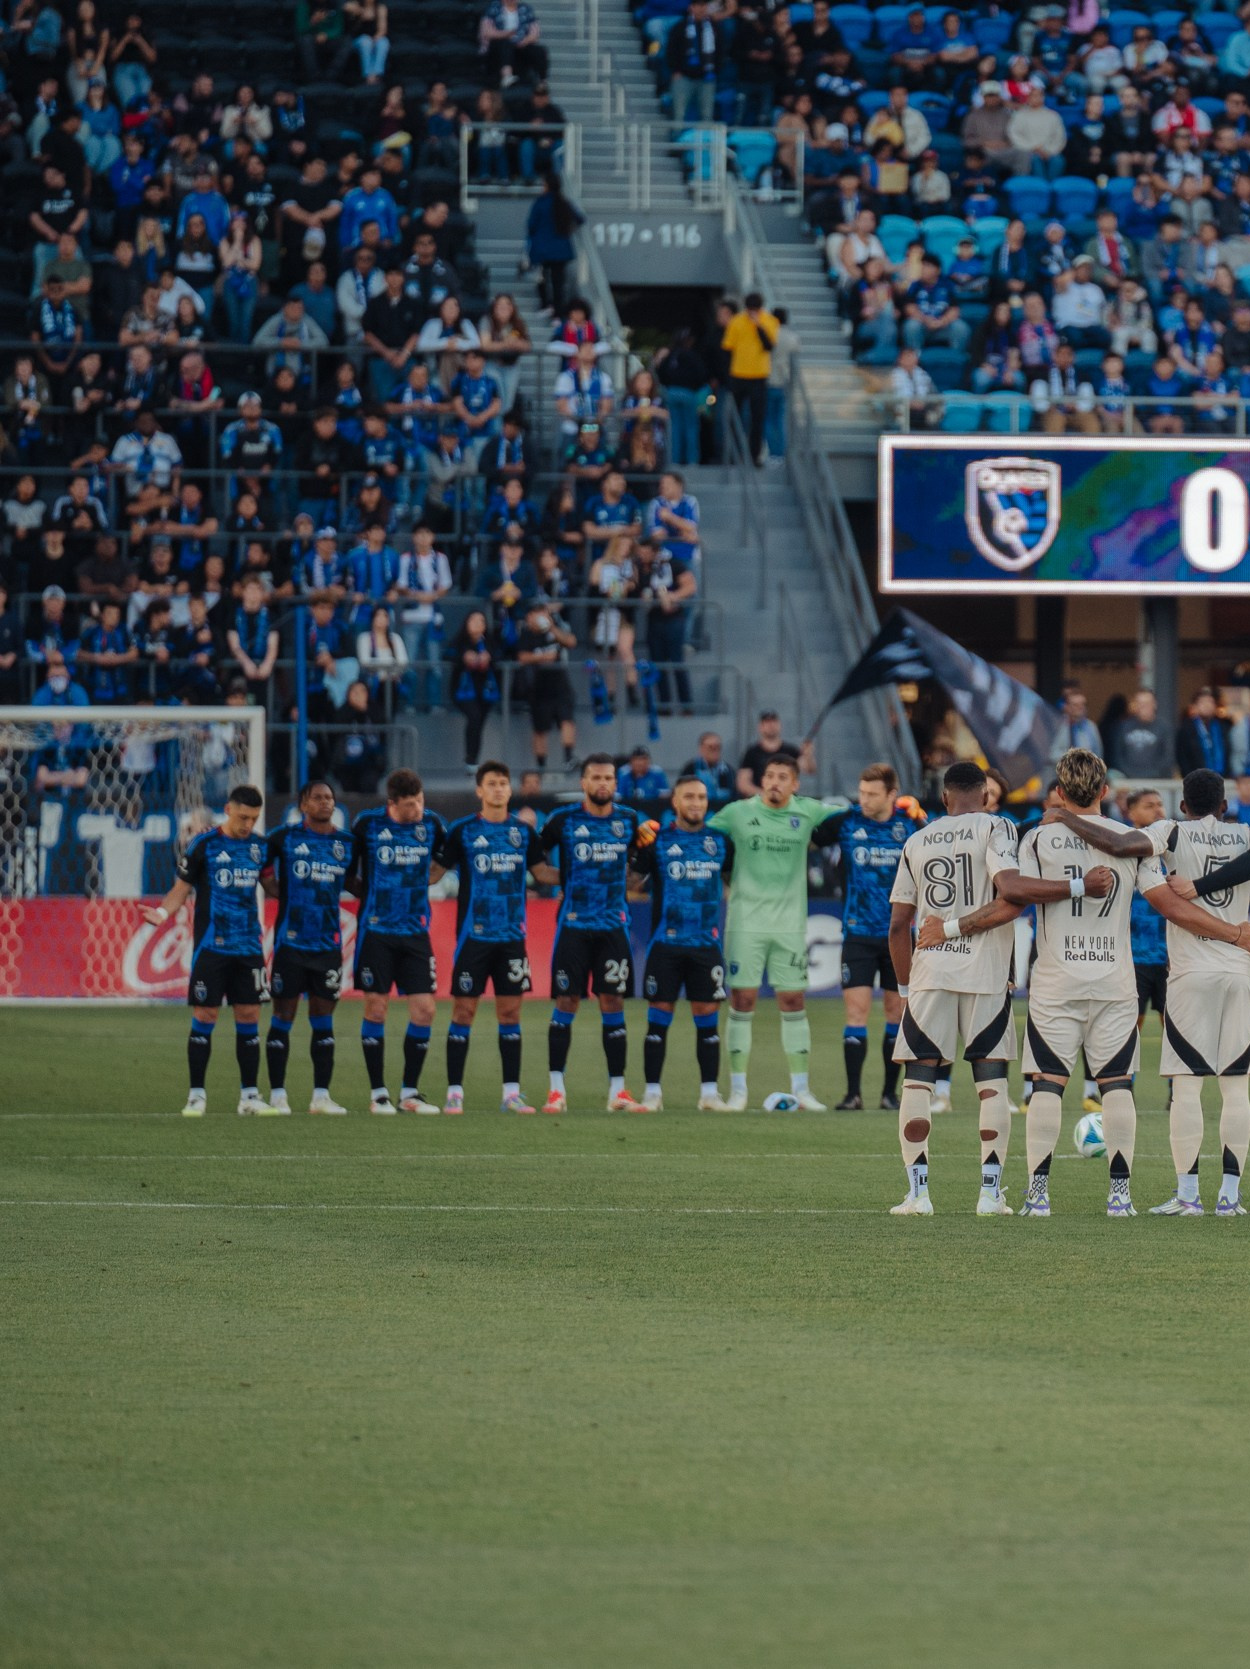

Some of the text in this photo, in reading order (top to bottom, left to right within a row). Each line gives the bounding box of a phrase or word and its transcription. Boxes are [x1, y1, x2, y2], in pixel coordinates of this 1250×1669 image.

[593, 222, 701, 248] 117 116
[1181, 467, 1248, 573] 0
[923, 828, 974, 847] NGOMA
[924, 852, 975, 910] 81
[1065, 935, 1115, 951] NEW YORK
[604, 958, 630, 983] 26
[711, 965, 725, 988] 9
